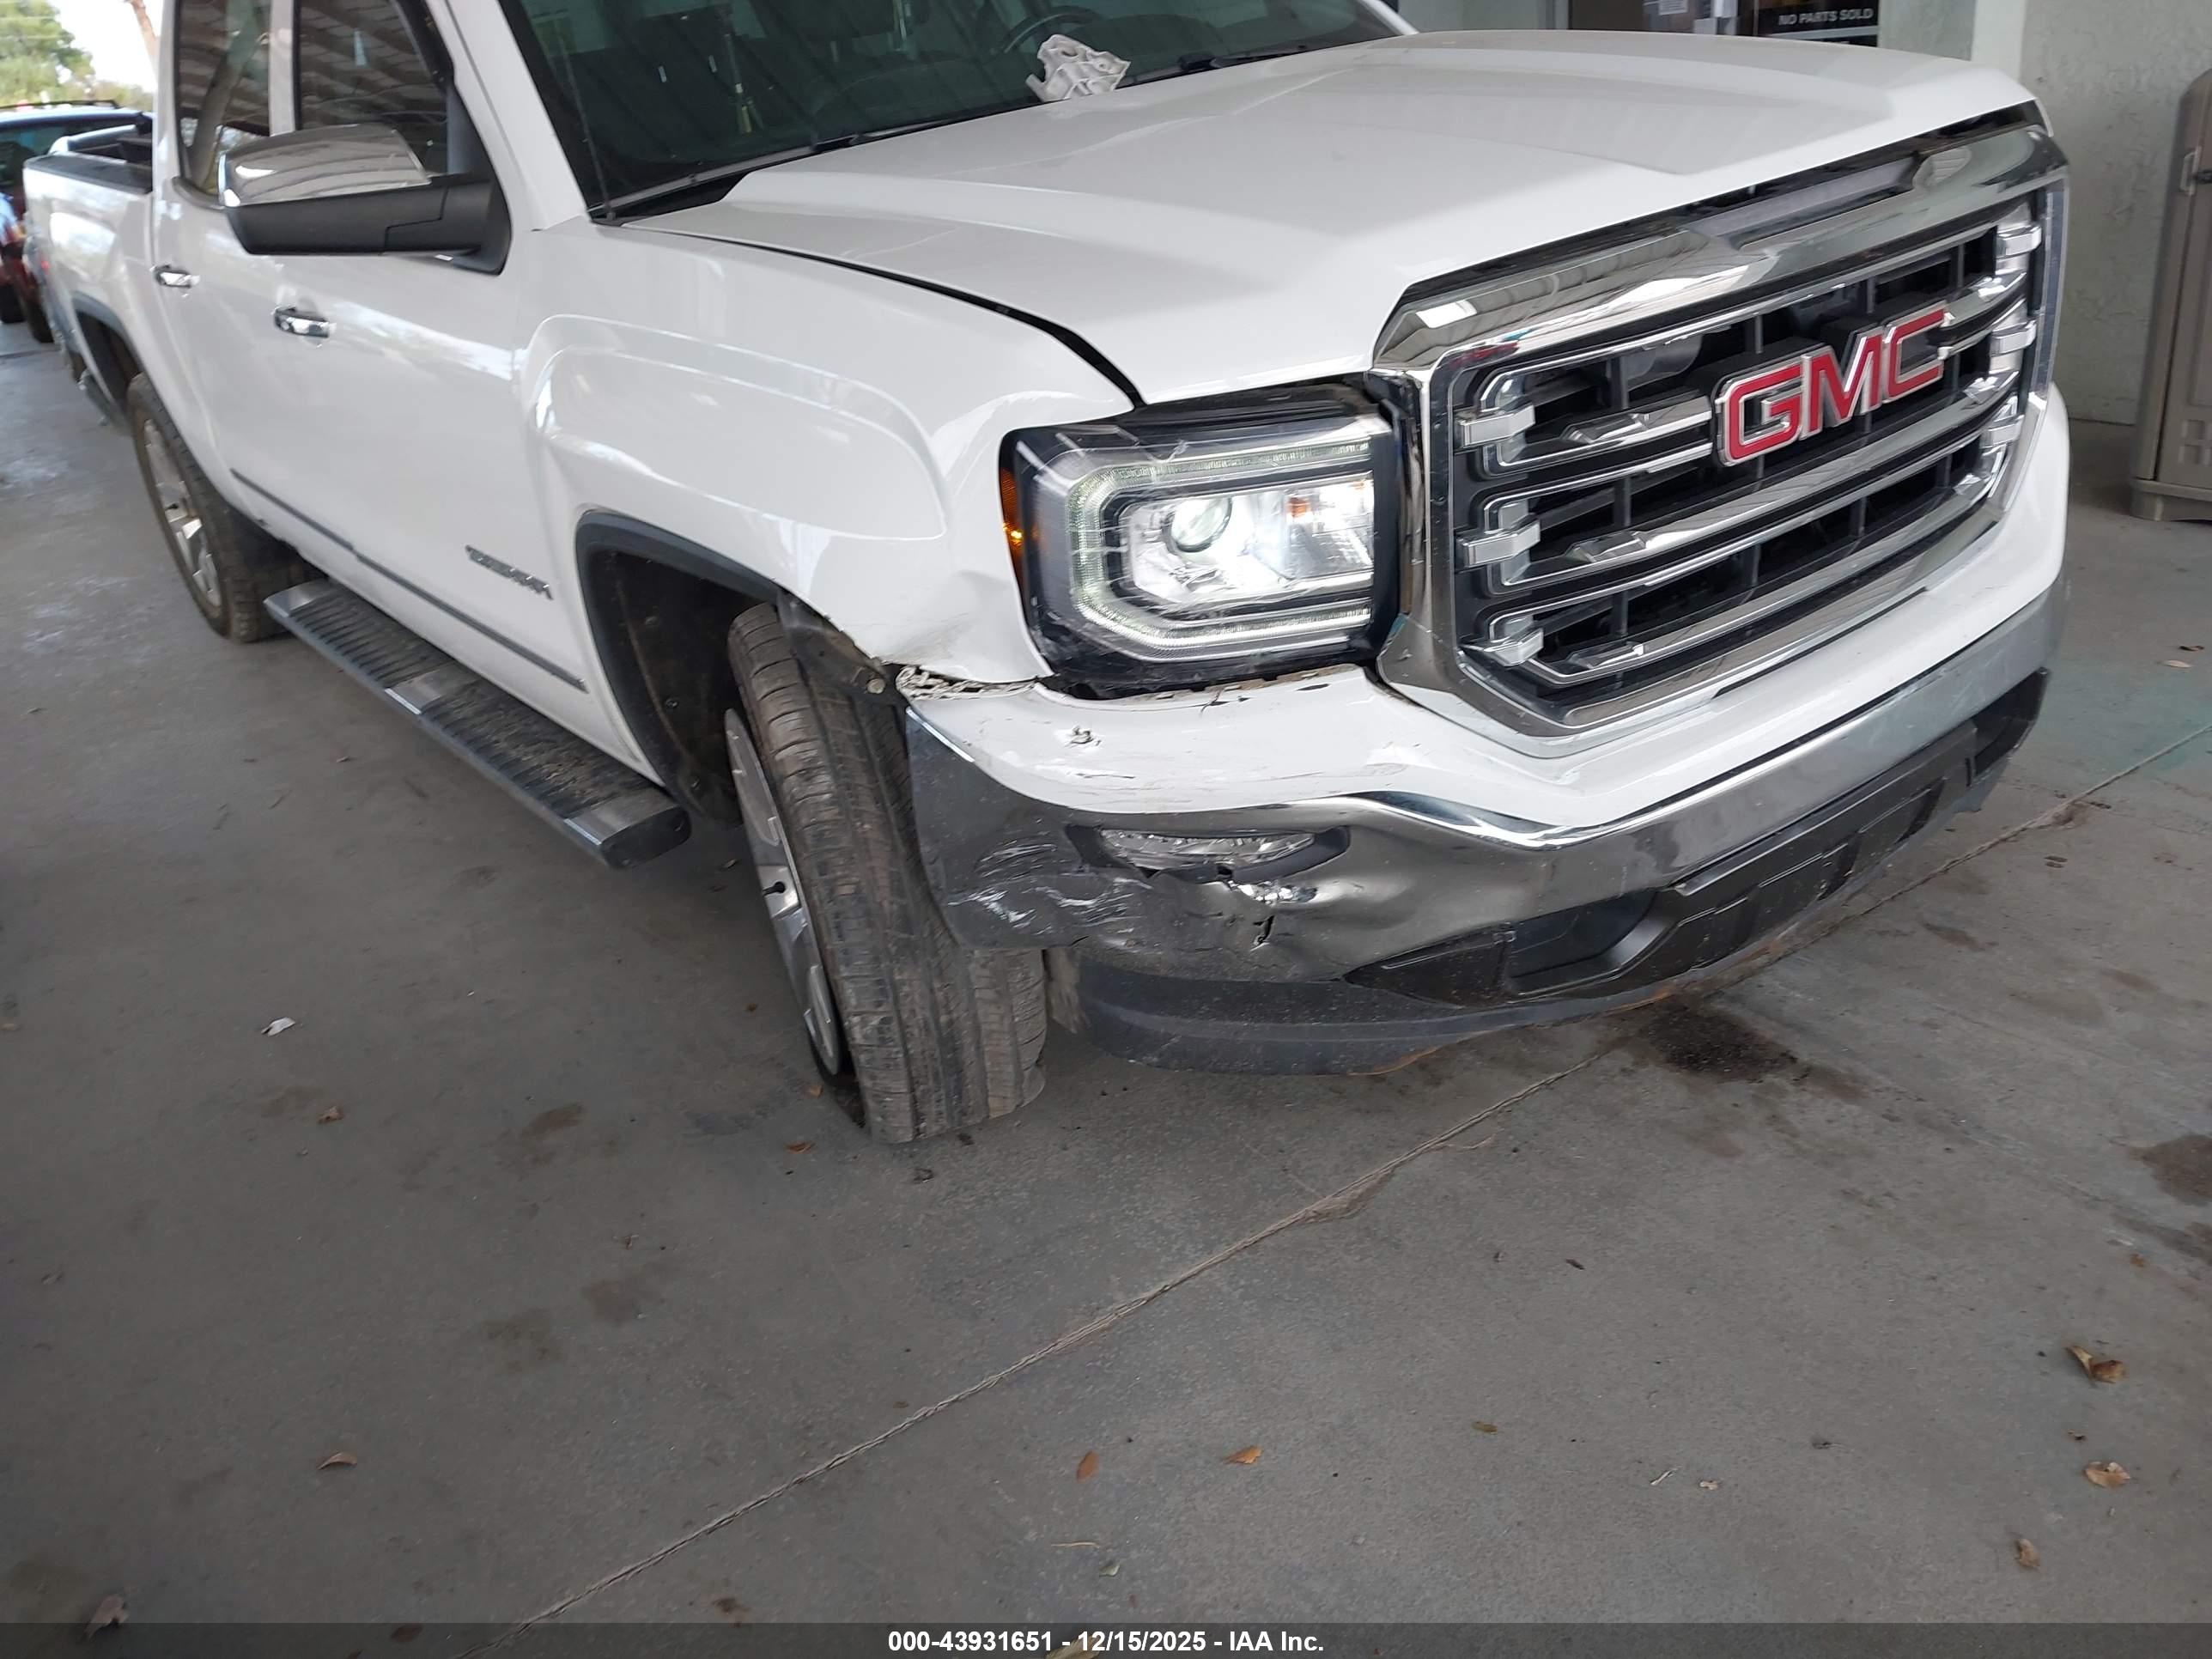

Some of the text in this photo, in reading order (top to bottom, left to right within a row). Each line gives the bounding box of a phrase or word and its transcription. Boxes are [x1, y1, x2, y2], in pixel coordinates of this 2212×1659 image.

[1778, 8, 1874, 25] NO PARTS SOLD
[1715, 301, 1952, 466] GMC
